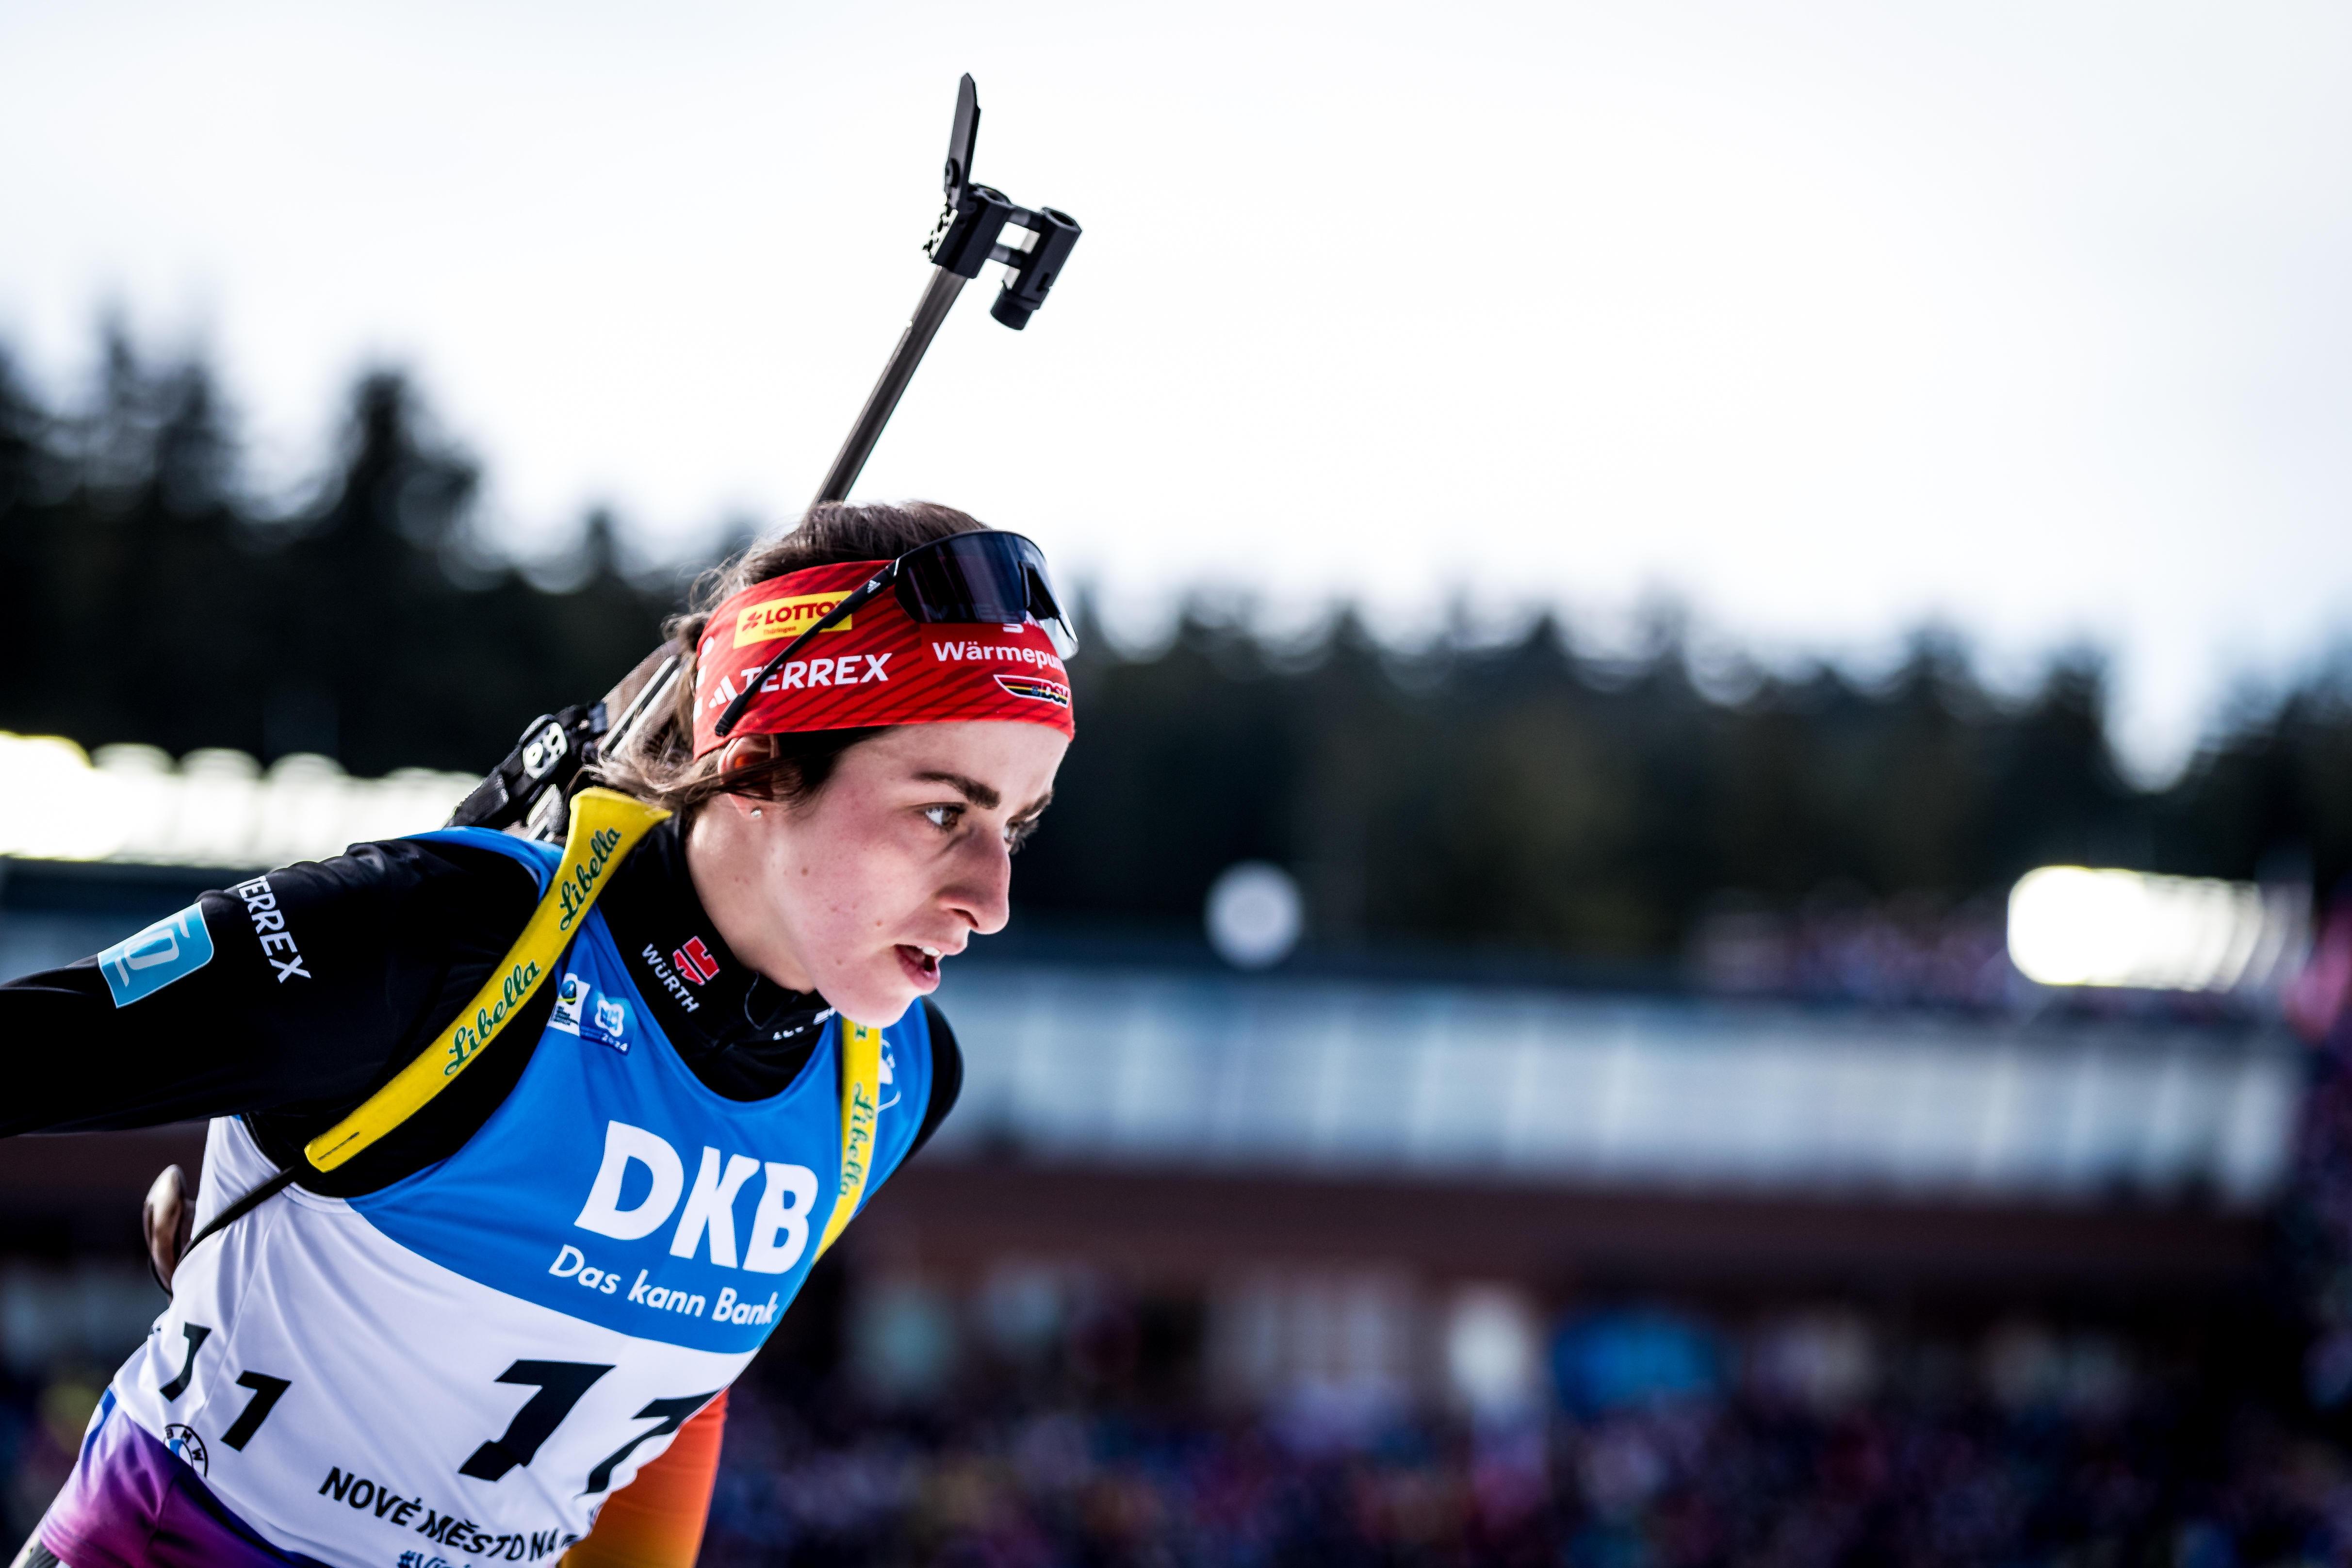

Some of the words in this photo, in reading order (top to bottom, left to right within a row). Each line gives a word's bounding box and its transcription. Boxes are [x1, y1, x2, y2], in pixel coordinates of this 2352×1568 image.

[765, 601, 835, 625] LOTTO
[932, 640, 1066, 673] Wärmepu
[740, 653, 892, 693] TERREX
[559, 826, 622, 932] Libella
[237, 875, 311, 983] TERREX
[443, 959, 541, 1077] Libella
[642, 943, 700, 1013] WÜRTH
[840, 1082, 874, 1196] Libella
[574, 1120, 819, 1274] DKB
[548, 1244, 622, 1294] Das
[627, 1269, 706, 1317] kann
[711, 1287, 779, 1325] Bank
[318, 1466, 422, 1527] NOVÉ
[415, 1509, 525, 1562] MĚSTO
